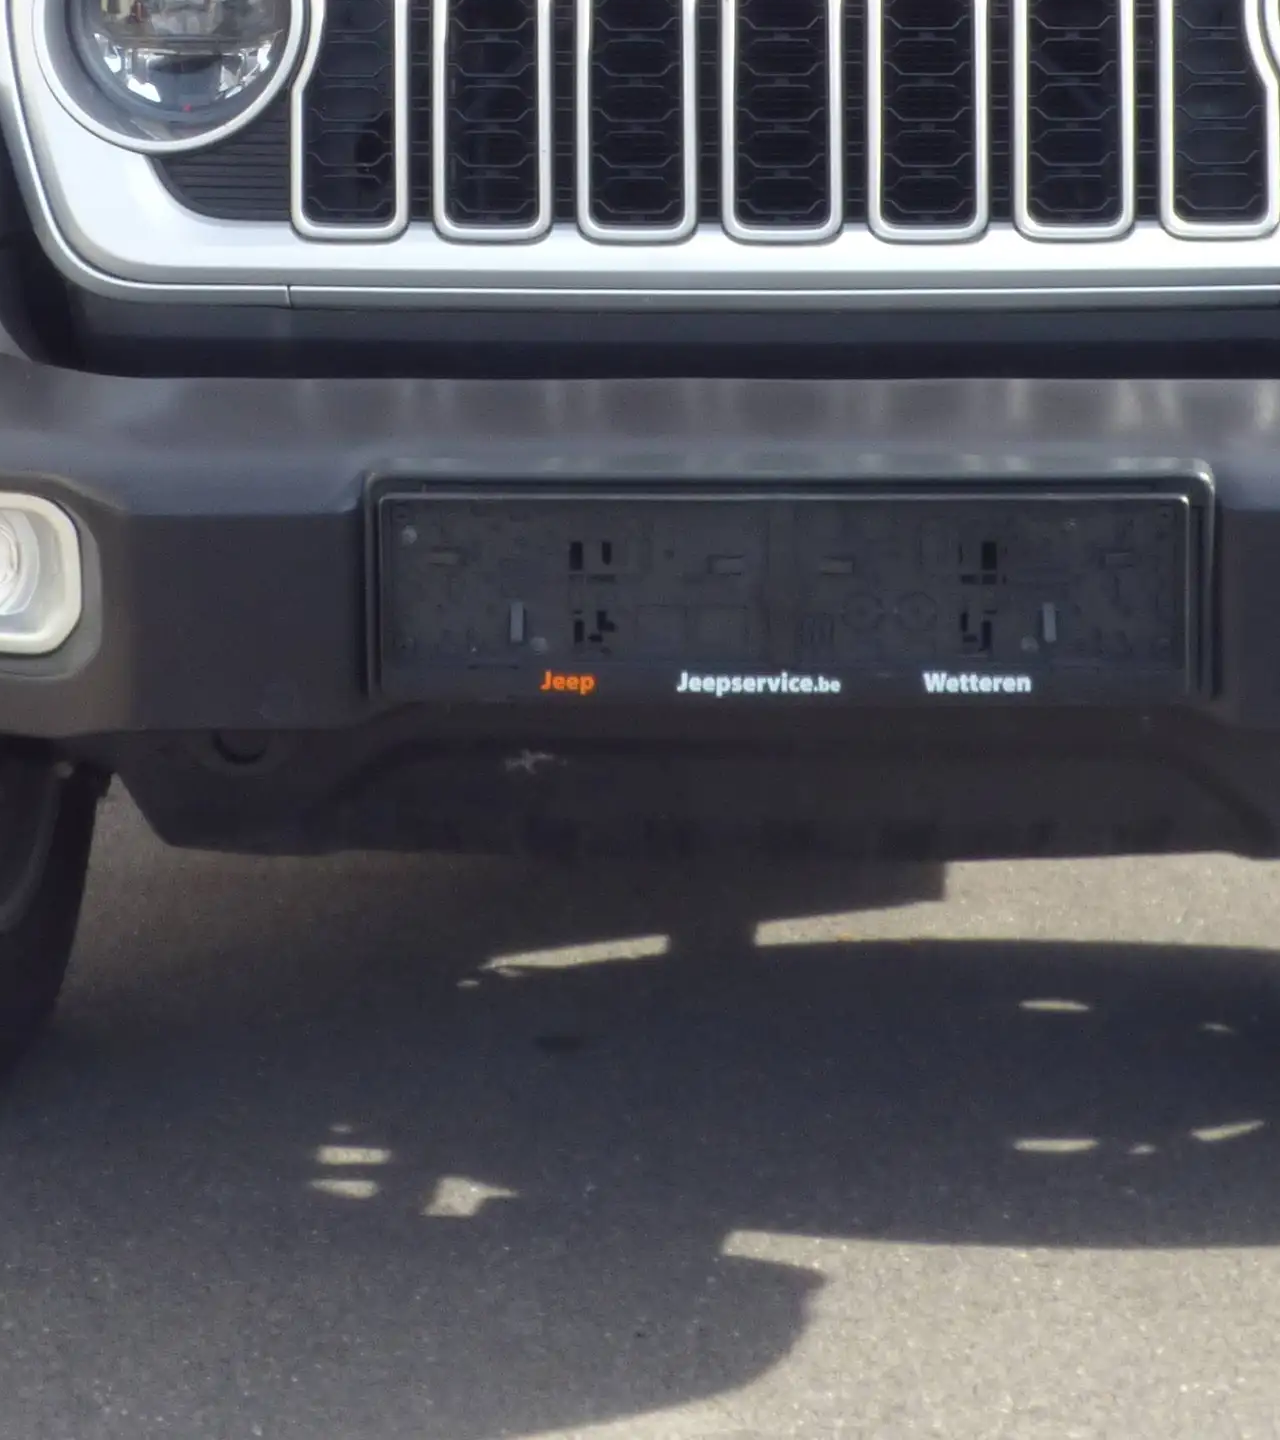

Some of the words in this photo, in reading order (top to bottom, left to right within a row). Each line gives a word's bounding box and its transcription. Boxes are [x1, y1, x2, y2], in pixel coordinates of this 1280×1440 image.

[540, 671, 595, 696] Jeep
[676, 671, 841, 697] Jeepservice.be
[923, 672, 1031, 694] Wetteren
